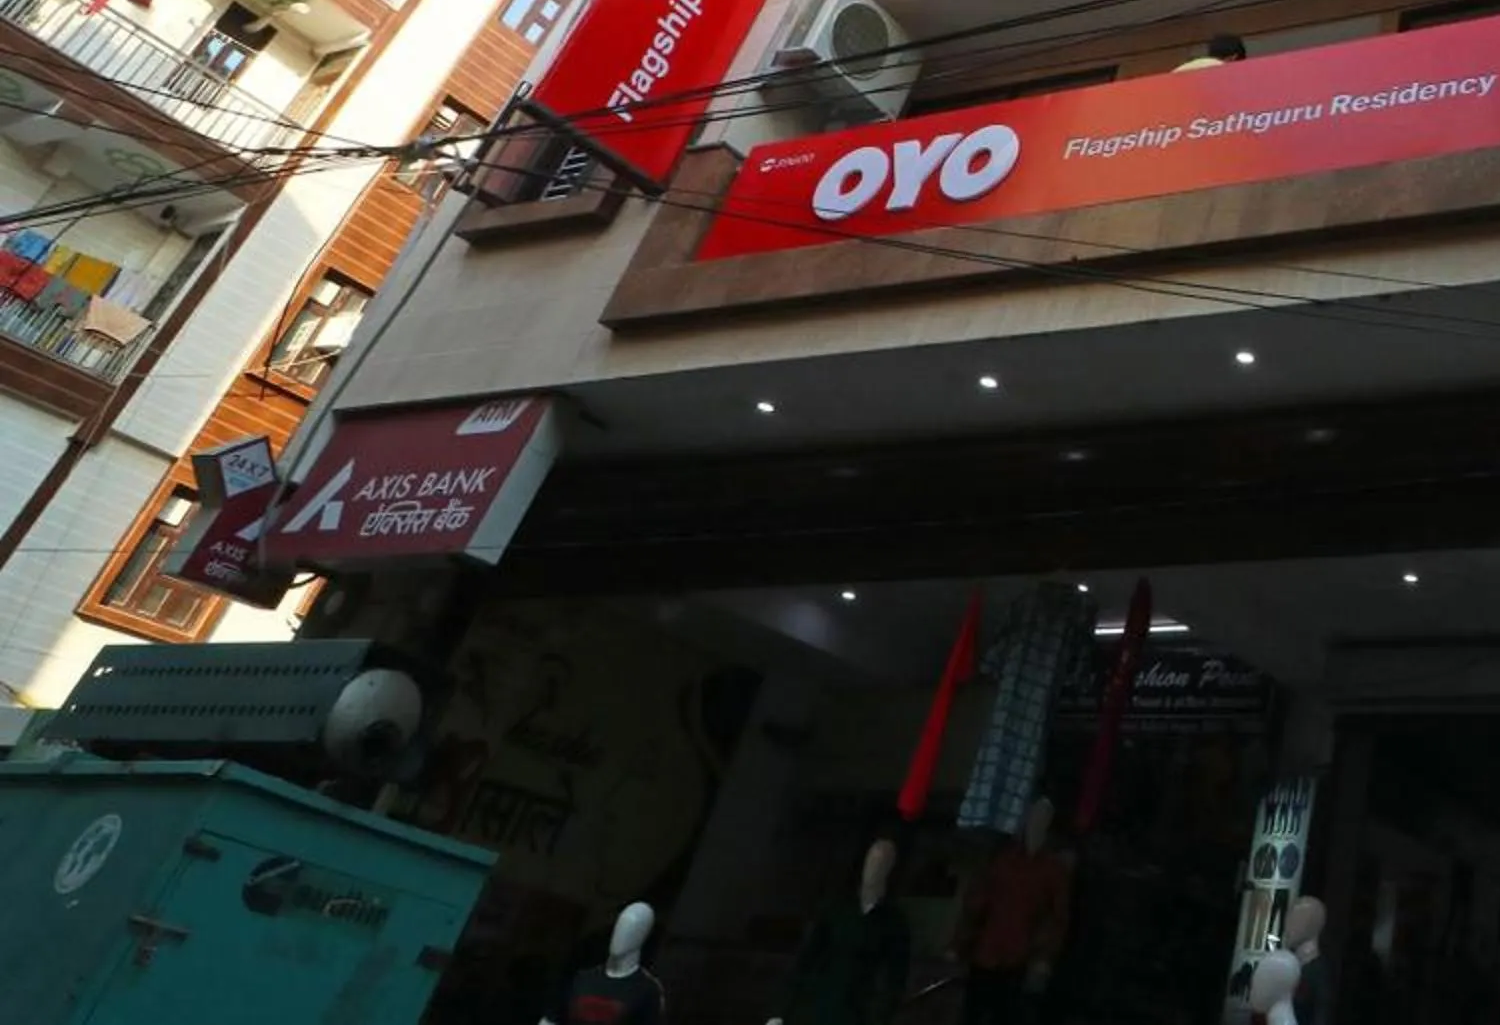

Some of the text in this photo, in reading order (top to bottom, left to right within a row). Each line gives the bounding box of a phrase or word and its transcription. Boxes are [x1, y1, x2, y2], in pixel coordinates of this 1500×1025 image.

[1063, 73, 1497, 159] Flagship Sathguru Residency
[811, 124, 1021, 221] OYO
[352, 466, 497, 501] AXIS BANK
[209, 539, 249, 563] AXIS
